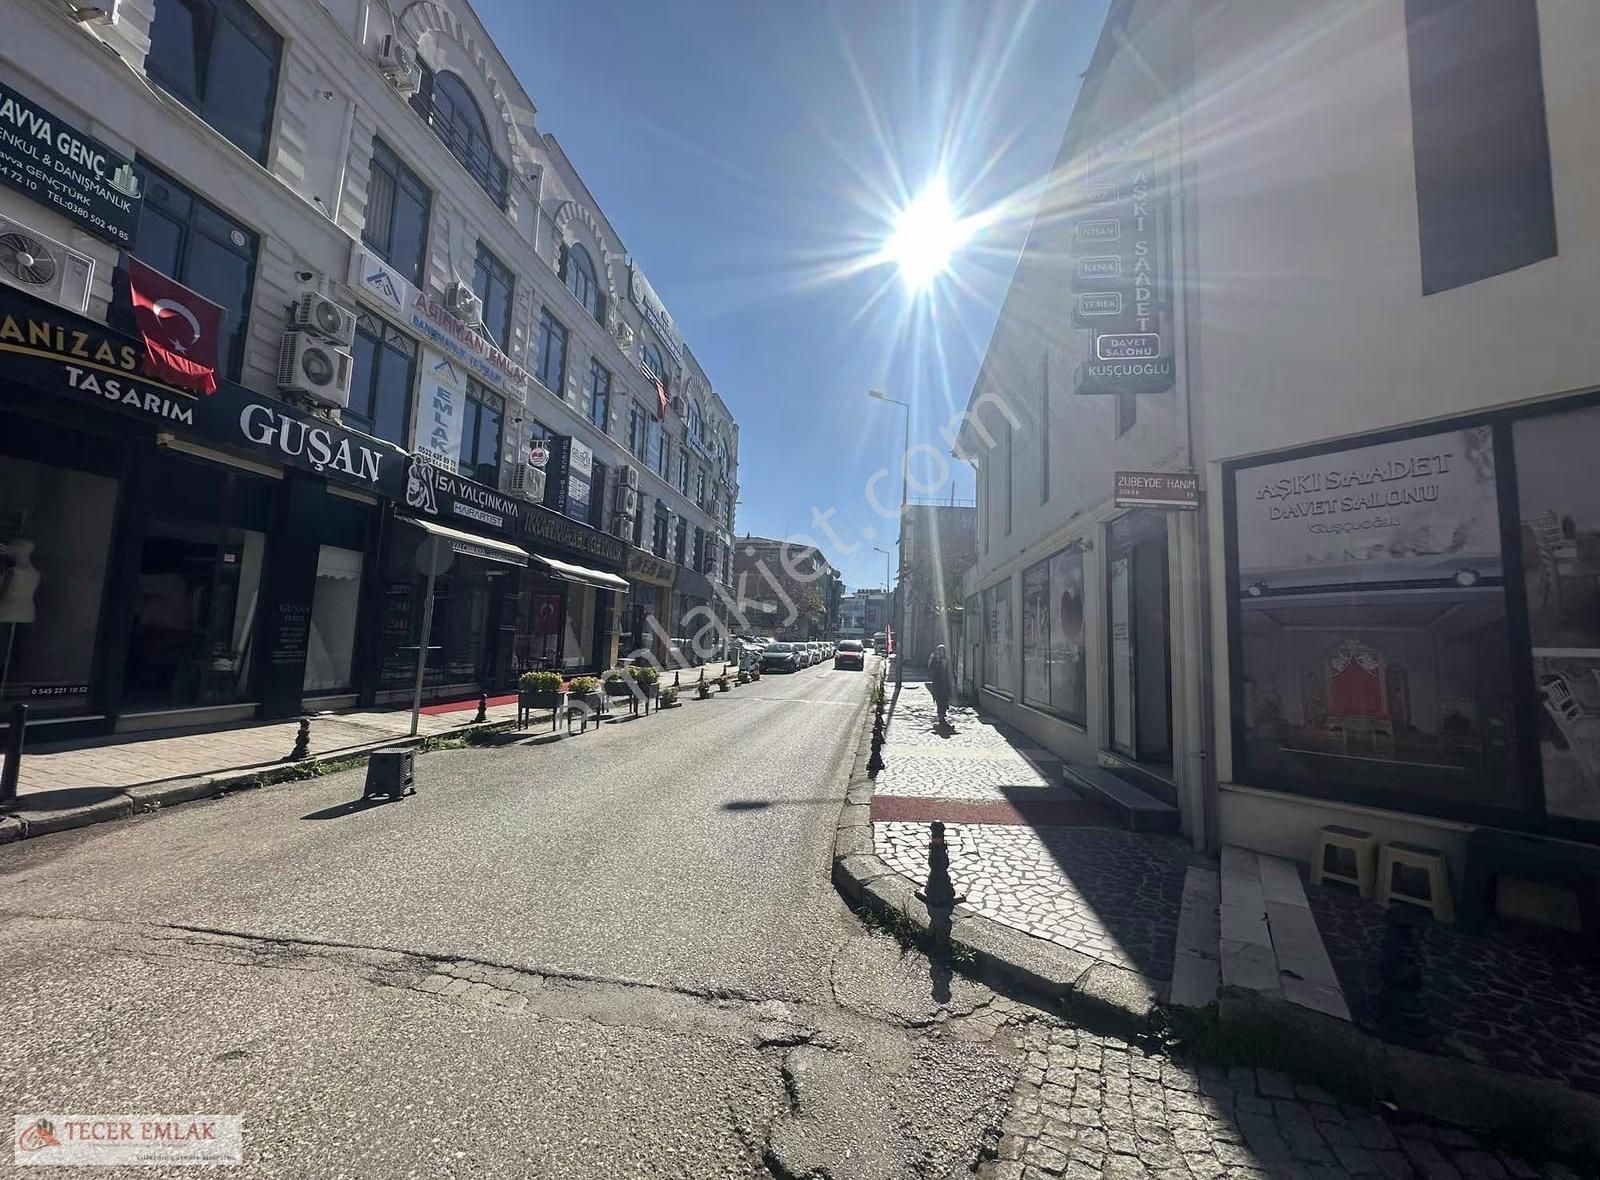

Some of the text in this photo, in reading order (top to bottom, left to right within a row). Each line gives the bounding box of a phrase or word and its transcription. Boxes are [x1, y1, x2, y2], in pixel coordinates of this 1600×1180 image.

[0, 94, 105, 180] AVVA GENÇ
[11, 170, 22, 183] 72
[26, 179, 37, 190] 10
[90, 214, 105, 229] 502
[107, 224, 118, 234] 40
[26, 165, 91, 206] GENÇTÜRK
[42, 154, 51, 166] &
[54, 160, 131, 213] DANIŞMANLIK
[1084, 298, 1117, 308] YEMEK
[1134, 241, 1152, 331] SAADET
[1105, 348, 1152, 357] SALONU
[1111, 339, 1146, 347] DAVET
[488, 346, 528, 386] EMLAK
[66, 366, 193, 425] TASARIM
[239, 403, 384, 483] GUŞAN
[1166, 479, 1196, 489] HANIM
[1325, 454, 1453, 491] SAADET
[435, 470, 519, 517] İSA YALÇINKAYA
[1270, 484, 1440, 521] DAVET SALONU
